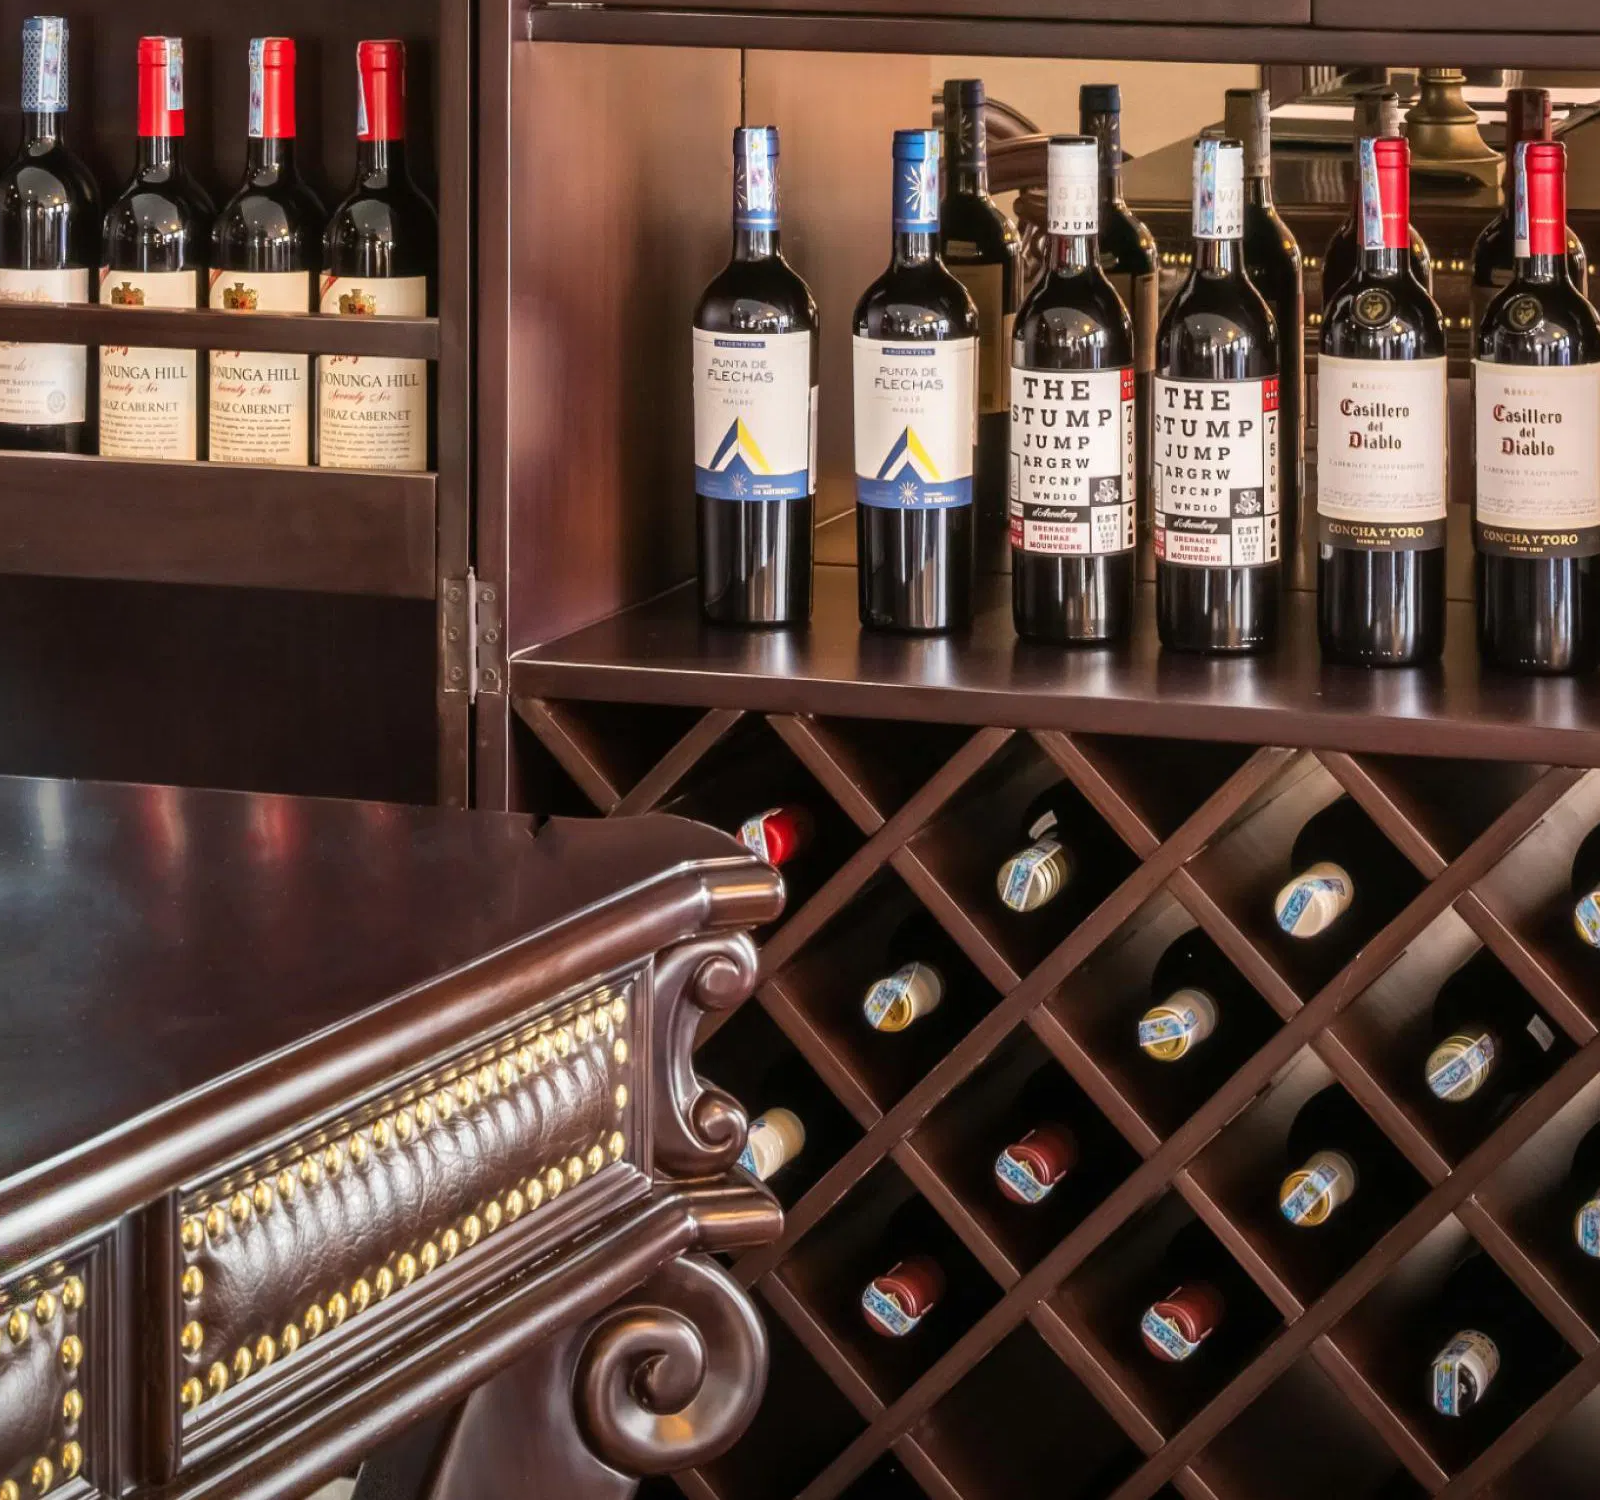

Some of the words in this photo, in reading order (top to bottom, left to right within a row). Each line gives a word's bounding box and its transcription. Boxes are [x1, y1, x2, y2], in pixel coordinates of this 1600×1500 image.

[712, 358, 748, 369] PUNTA
[751, 360, 767, 369] DE
[155, 366, 188, 380] HILL
[267, 368, 302, 381] HILL
[707, 369, 774, 383] FLECHAS
[879, 367, 919, 376] PUNTA
[921, 368, 938, 376] DE
[387, 373, 420, 387] HILL
[874, 378, 944, 391] FLECHAS
[1023, 377, 1090, 400] THE
[1165, 387, 1230, 411] THE
[121, 402, 179, 413] CABERNET
[232, 403, 292, 414] CABERNET
[1340, 399, 1409, 418] Casillero
[1493, 404, 1562, 424] Casillero
[351, 409, 412, 421] CABERNET
[1012, 404, 1112, 428] STUMP
[1156, 414, 1253, 438] STUMP
[1368, 421, 1383, 432] del
[1519, 427, 1535, 438] del
[1023, 433, 1090, 449] JUMP
[1349, 431, 1402, 450] Diablo
[1501, 437, 1555, 456] Diablo
[1165, 443, 1231, 460] JUMP
[1023, 455, 1090, 469] ARGRW
[1165, 465, 1231, 480] ARGRW
[1029, 474, 1082, 486] CFCNP
[1171, 485, 1222, 497] CFCNP
[1097, 513, 1118, 523] EST
[1032, 525, 1078, 533] GRENACHE
[1238, 526, 1260, 535] EST
[1328, 523, 1376, 537] CONCHA
[1379, 528, 1387, 537] Y
[1388, 527, 1424, 538] TORO
[1039, 534, 1070, 542] SHIRAZ
[1174, 535, 1218, 545] GRENACHE
[1483, 529, 1530, 544] CONCHA
[1532, 536, 1539, 544] Y
[1541, 534, 1578, 545] TORO
[1180, 544, 1210, 552] SHIRAZ
